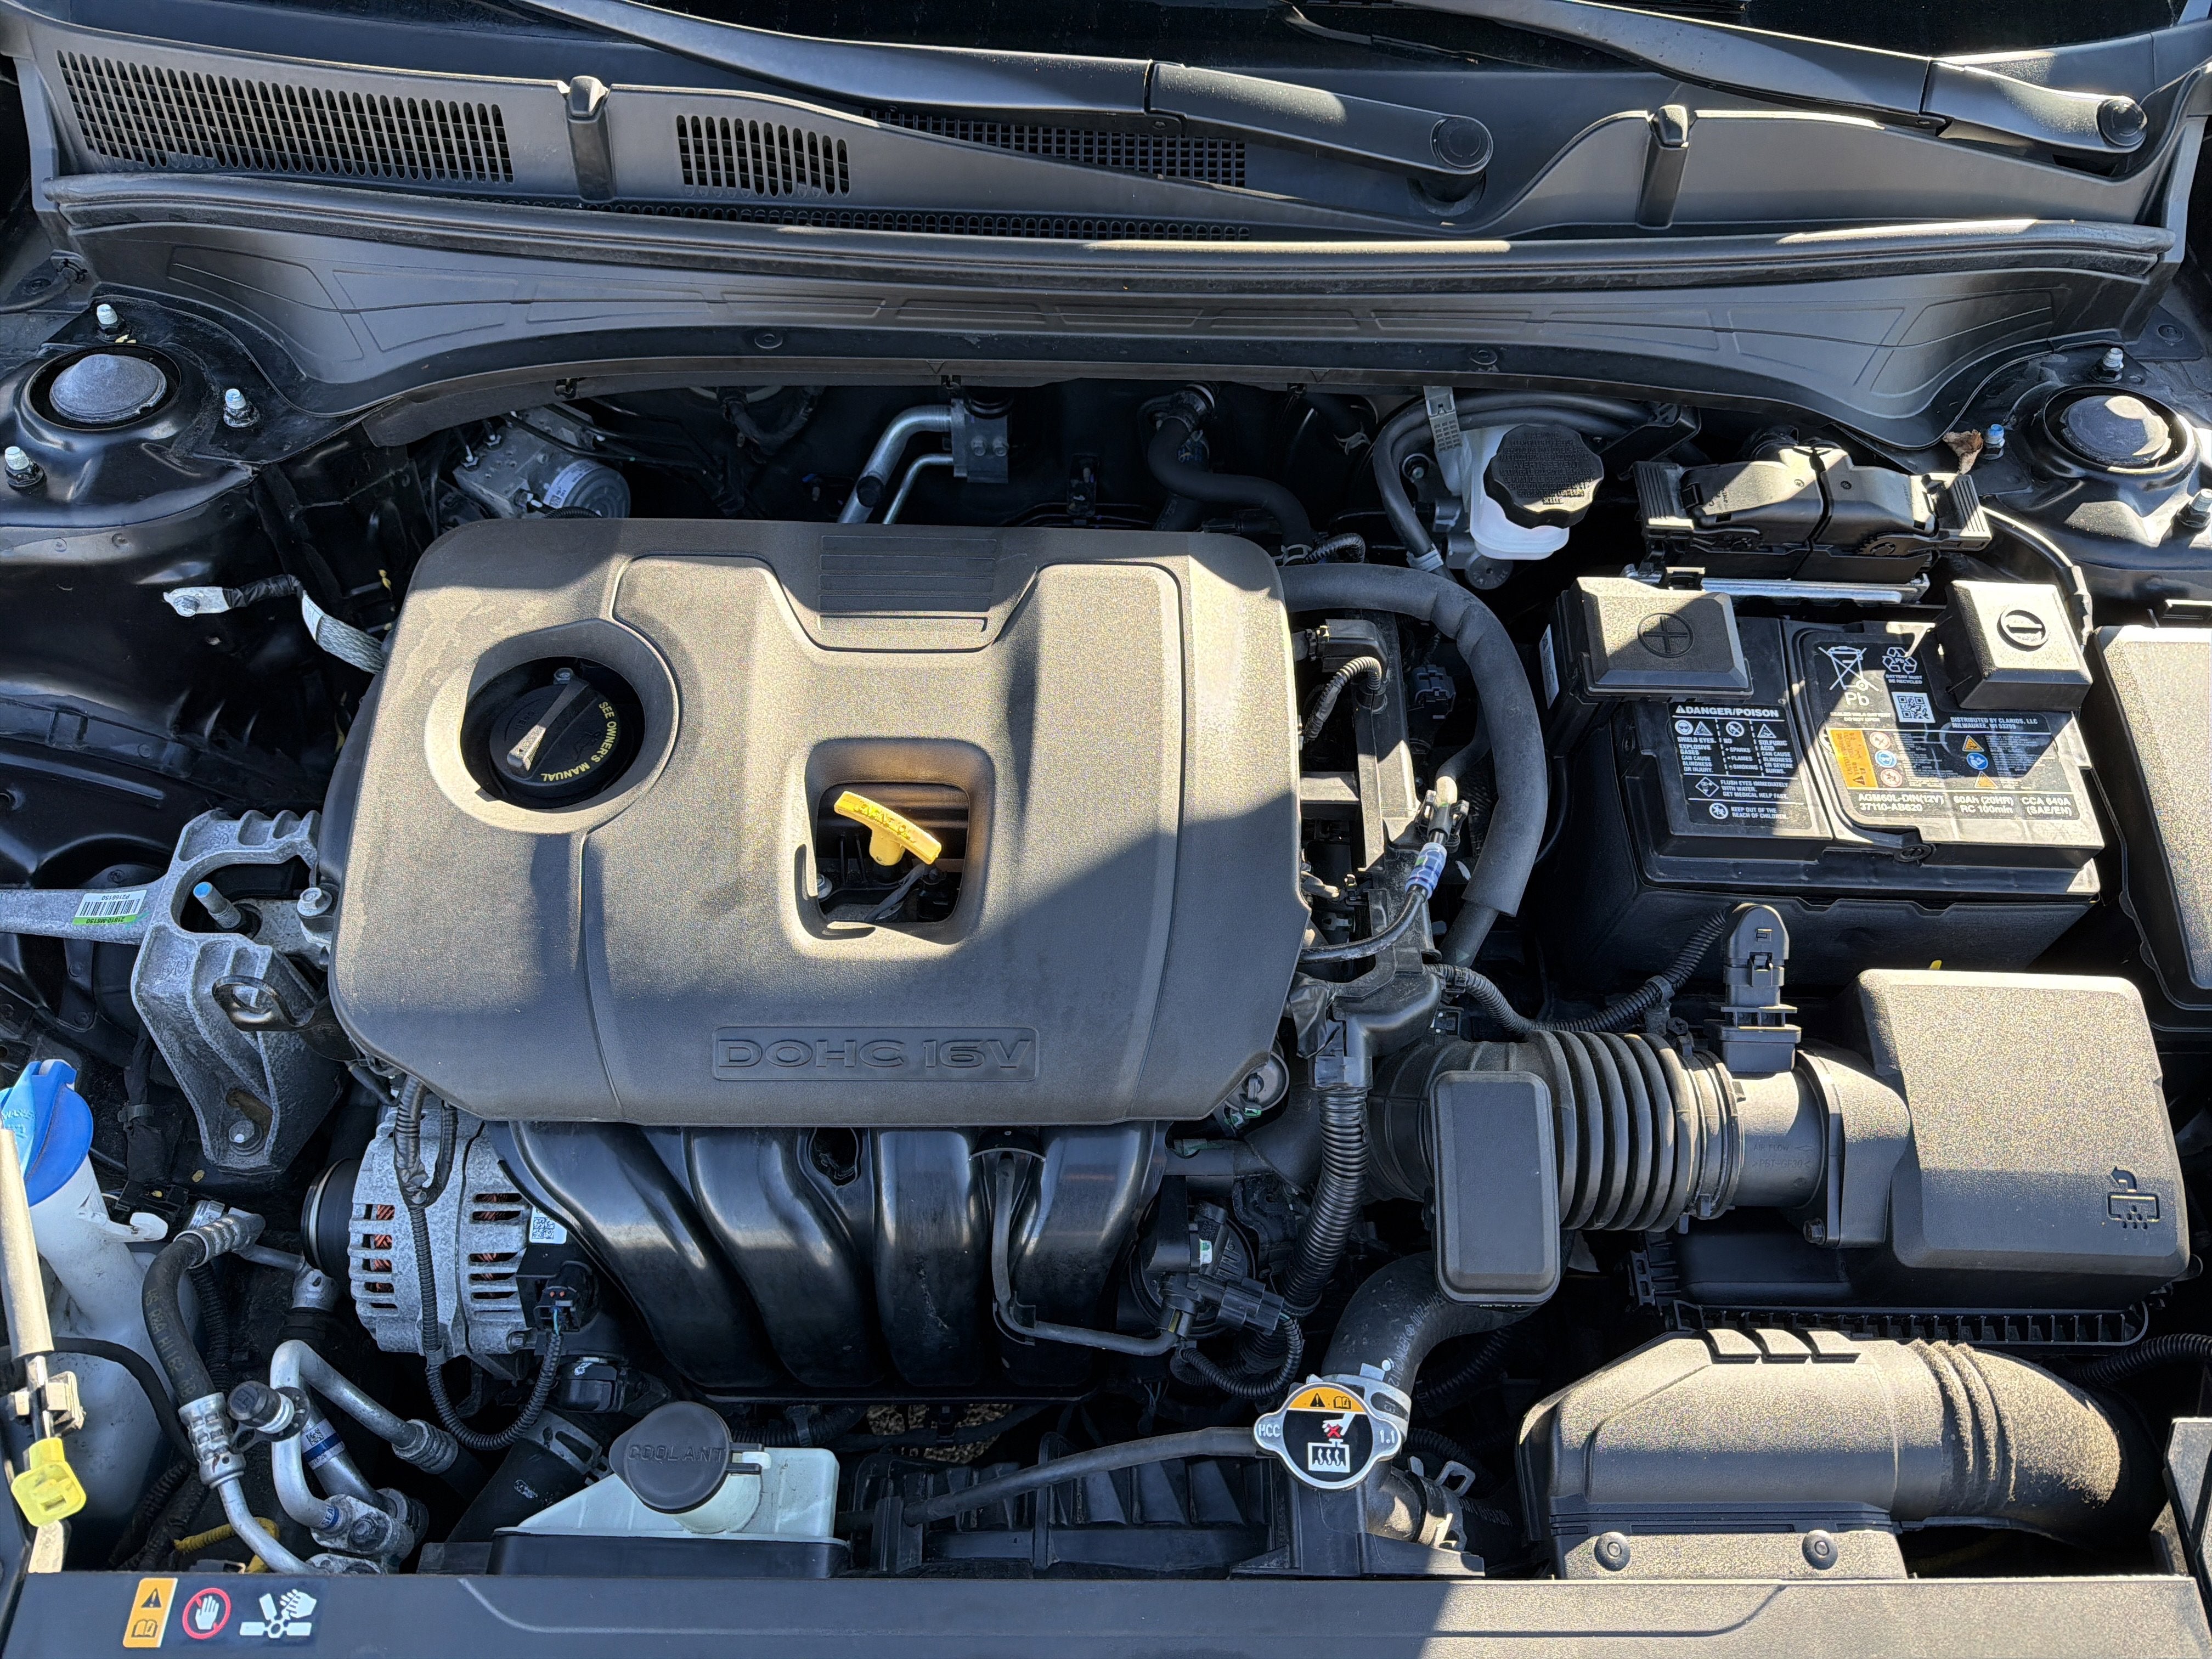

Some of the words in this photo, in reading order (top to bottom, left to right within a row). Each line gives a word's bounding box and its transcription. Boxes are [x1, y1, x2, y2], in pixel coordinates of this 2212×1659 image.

[1844, 692, 1870, 706] Pb
[599, 702, 614, 719] SEE
[1685, 706, 1779, 718] DANGER/POISON
[591, 721, 617, 763] OWNER'S
[541, 762, 590, 782] MANUAL
[1858, 793, 1944, 805] AGM60L-DIN(12V)
[1954, 795, 1979, 804] 60Ah
[1981, 797, 2014, 806] (20HR)
[2021, 797, 2045, 805] CCA
[2045, 797, 2072, 805] 640A
[1960, 805, 1976, 813] RC
[1977, 805, 2013, 814] 100min
[2027, 805, 2072, 816] (SAE/EN)
[718, 1039, 905, 1069] DOHC
[923, 1039, 1031, 1069] 16V
[1258, 1424, 1281, 1437] HCC
[1379, 1430, 1395, 1444] 1.1
[628, 1444, 725, 1463] COOLANT
